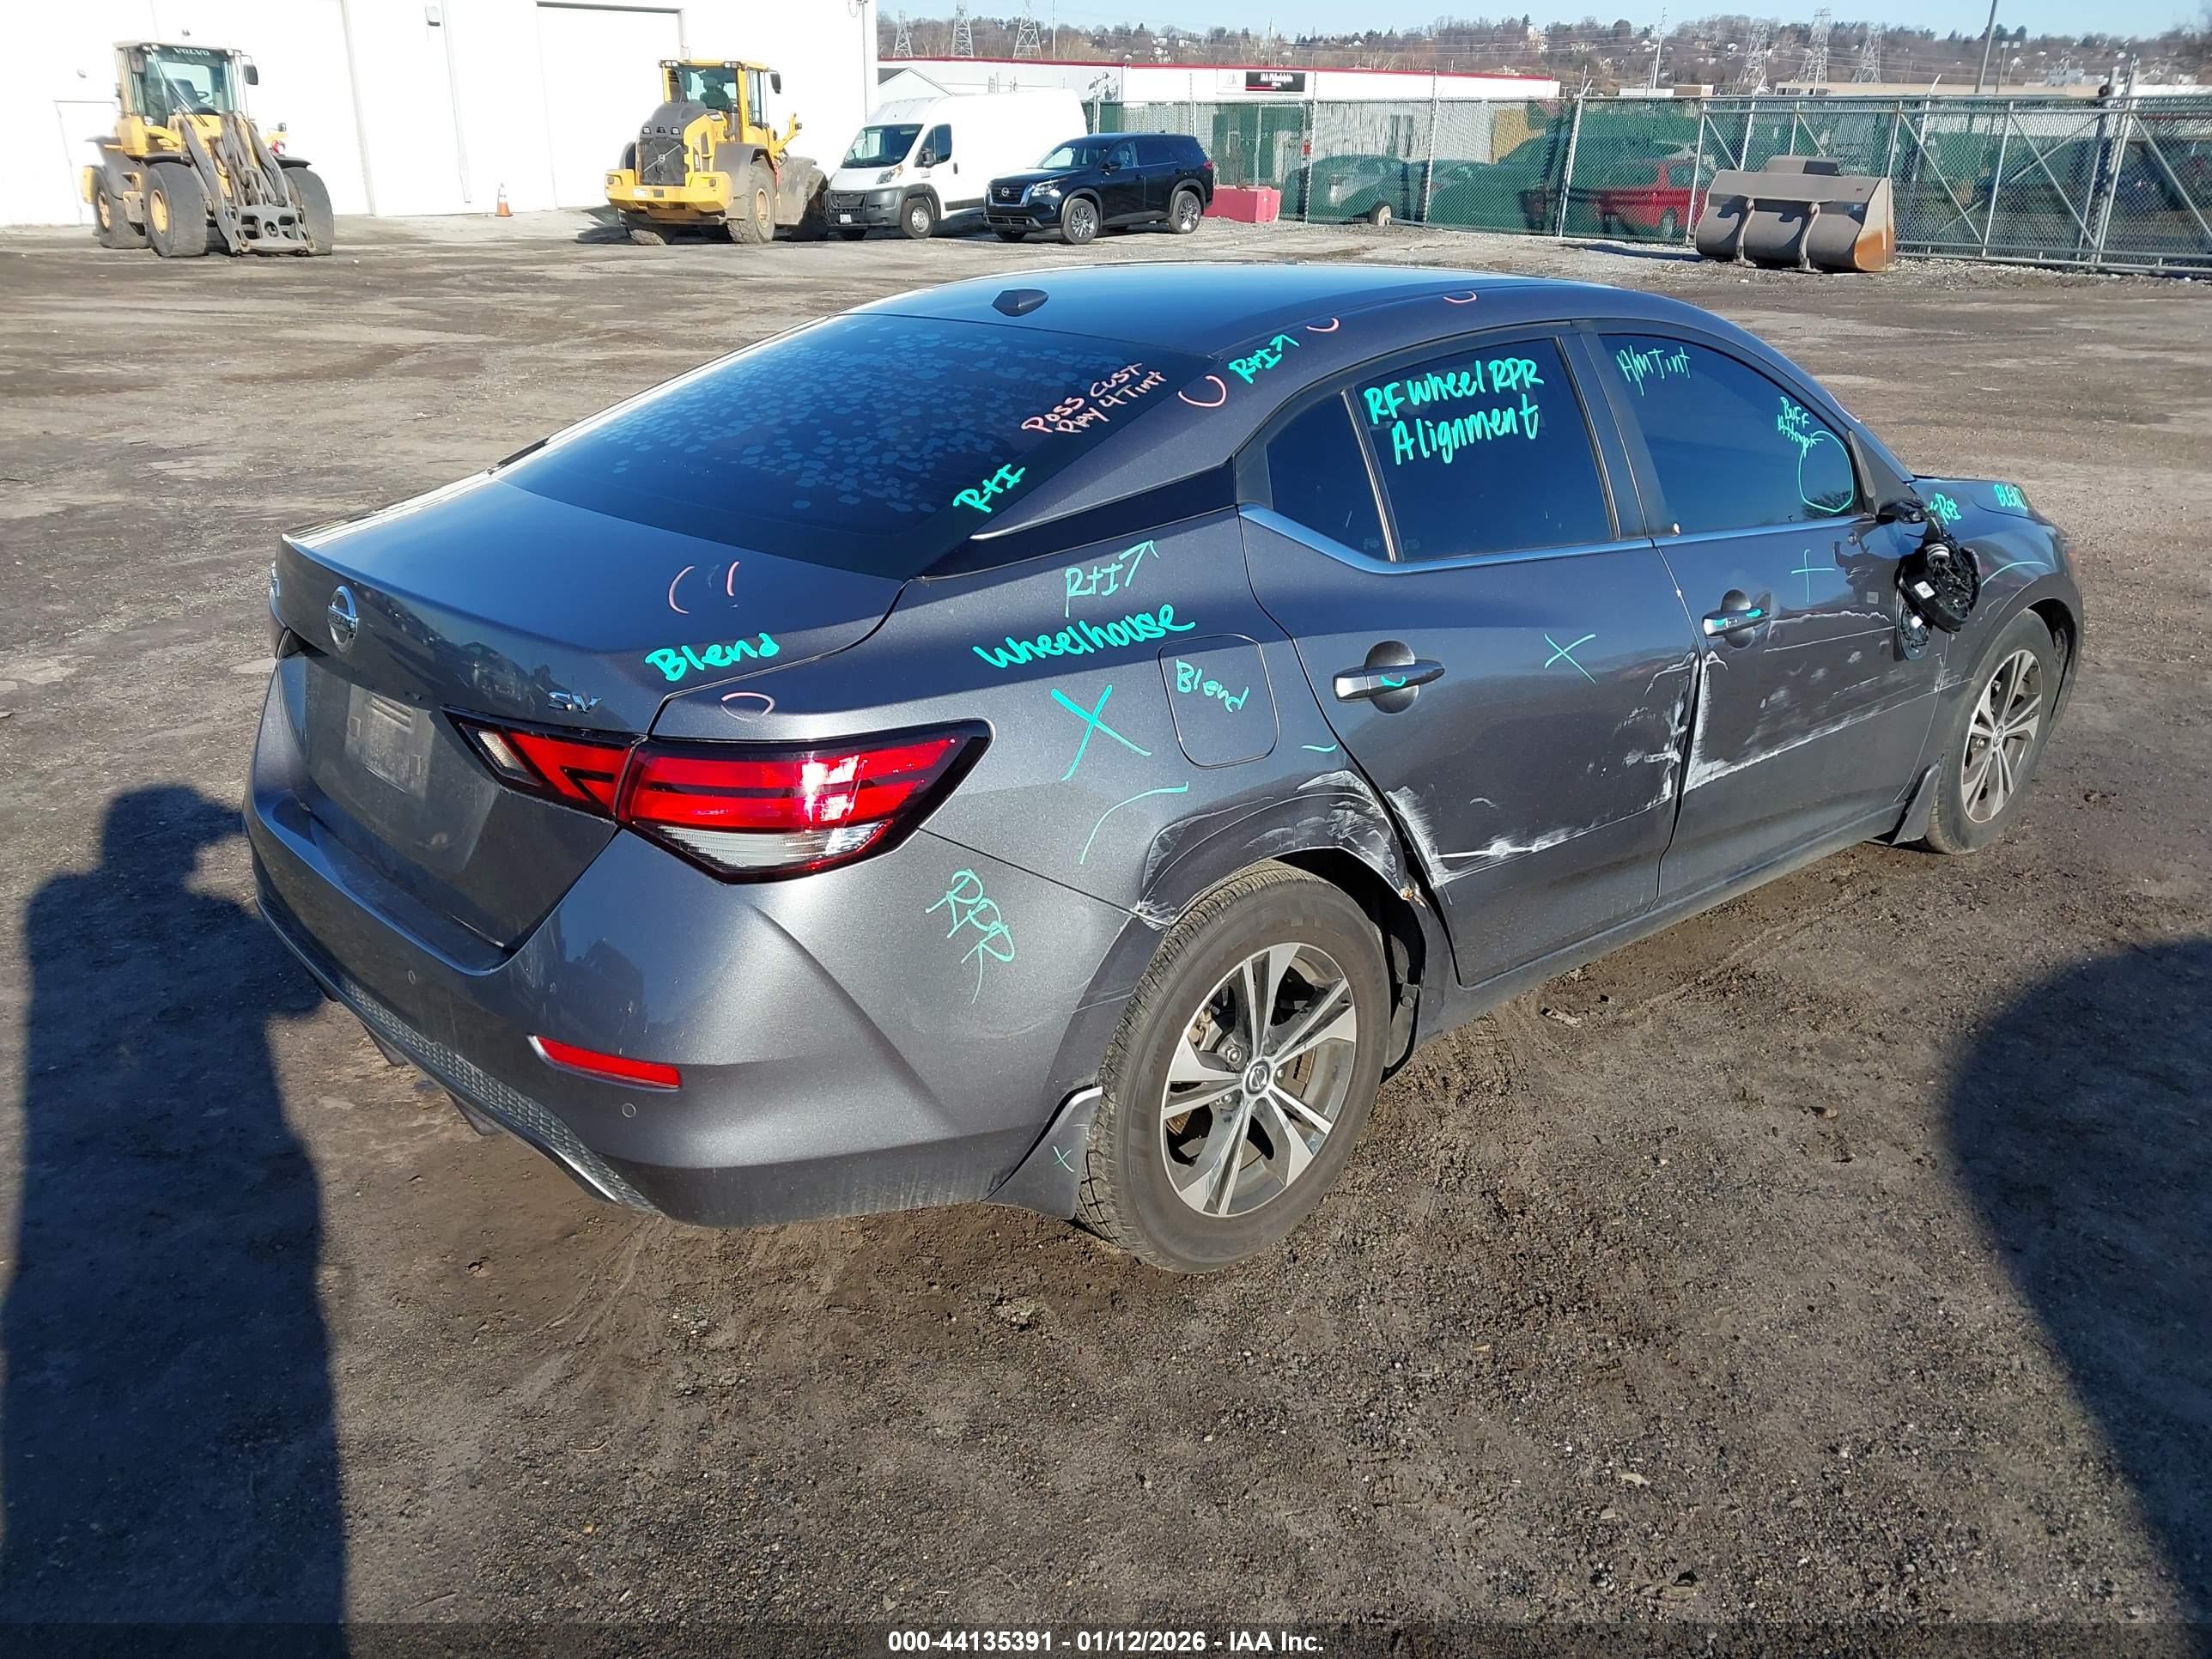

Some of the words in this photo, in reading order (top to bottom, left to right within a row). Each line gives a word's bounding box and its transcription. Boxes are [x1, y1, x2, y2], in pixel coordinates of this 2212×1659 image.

[172, 47, 210, 56] VOLVO
[1364, 382, 1407, 425] RF
[1486, 357, 1545, 394] RPR
[1391, 392, 1540, 465] Alignment
[644, 632, 781, 682] Blend
[548, 691, 603, 714] SV
